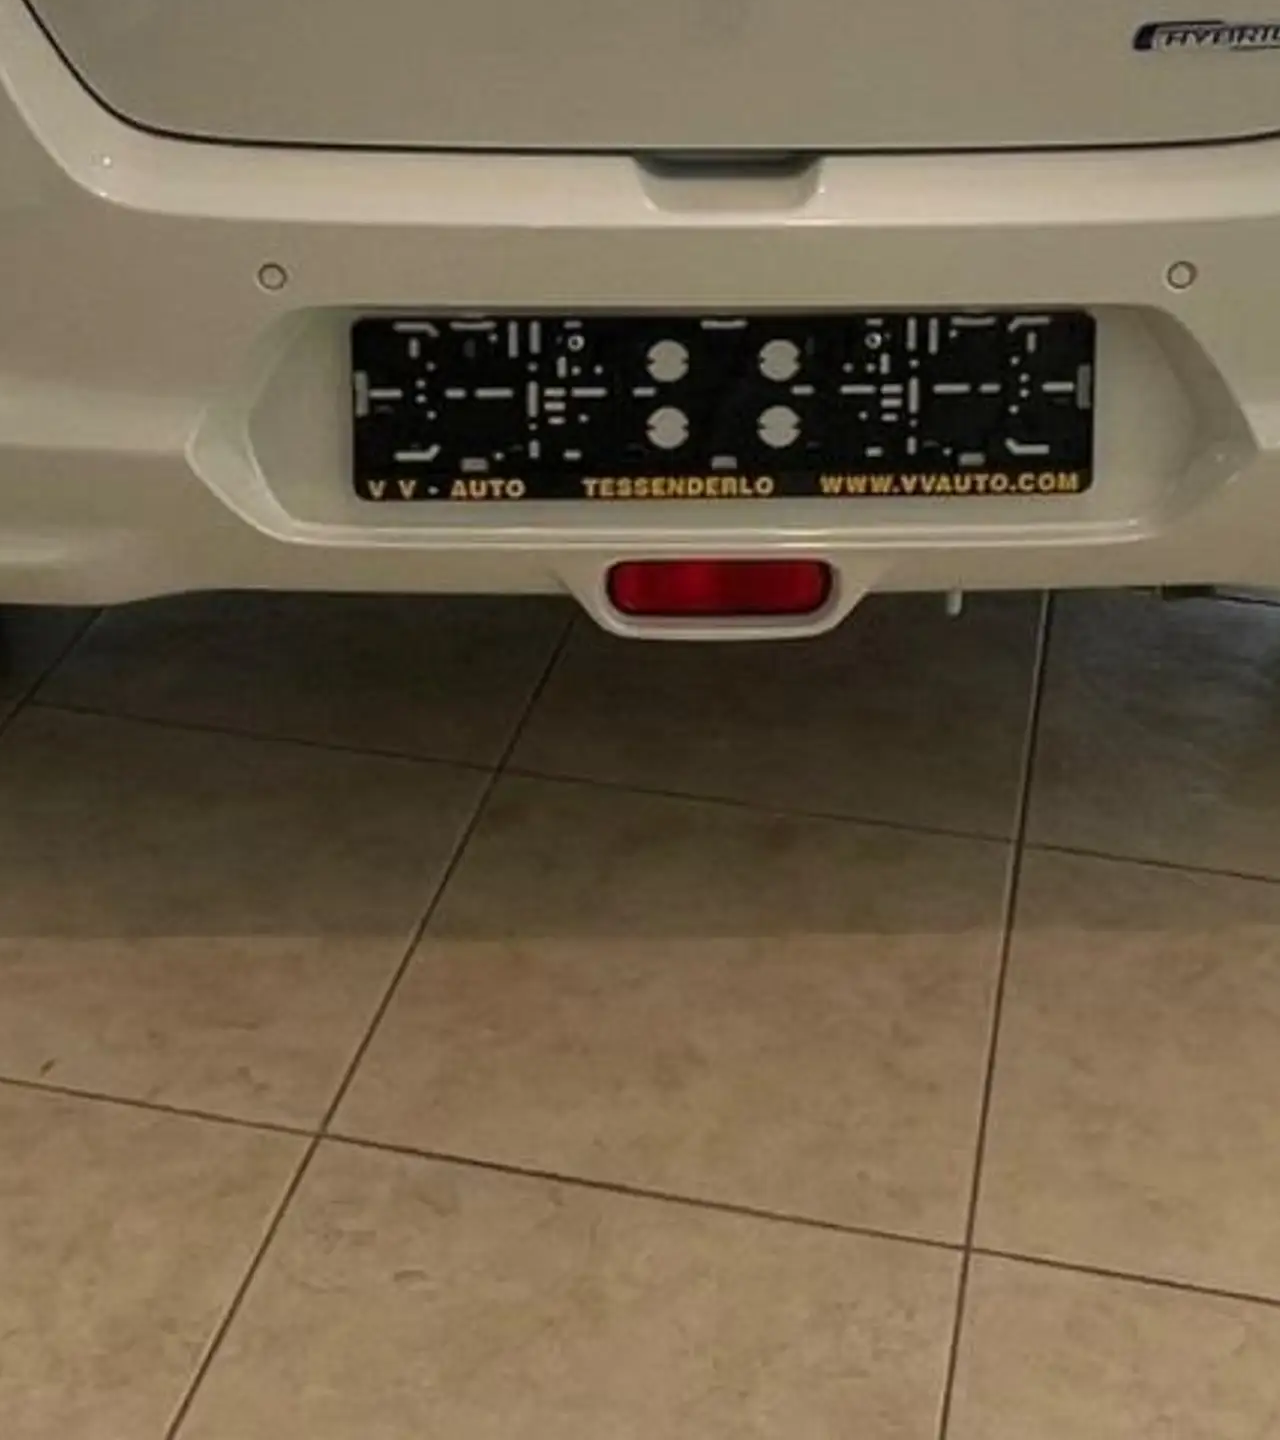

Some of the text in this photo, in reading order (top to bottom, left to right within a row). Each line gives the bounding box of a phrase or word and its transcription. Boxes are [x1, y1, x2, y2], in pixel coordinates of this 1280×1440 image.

[450, 479, 527, 499] AUTO
[581, 476, 775, 498] TESSENDERLO
[821, 472, 1080, 494] WWW.VVAUTO.COM
